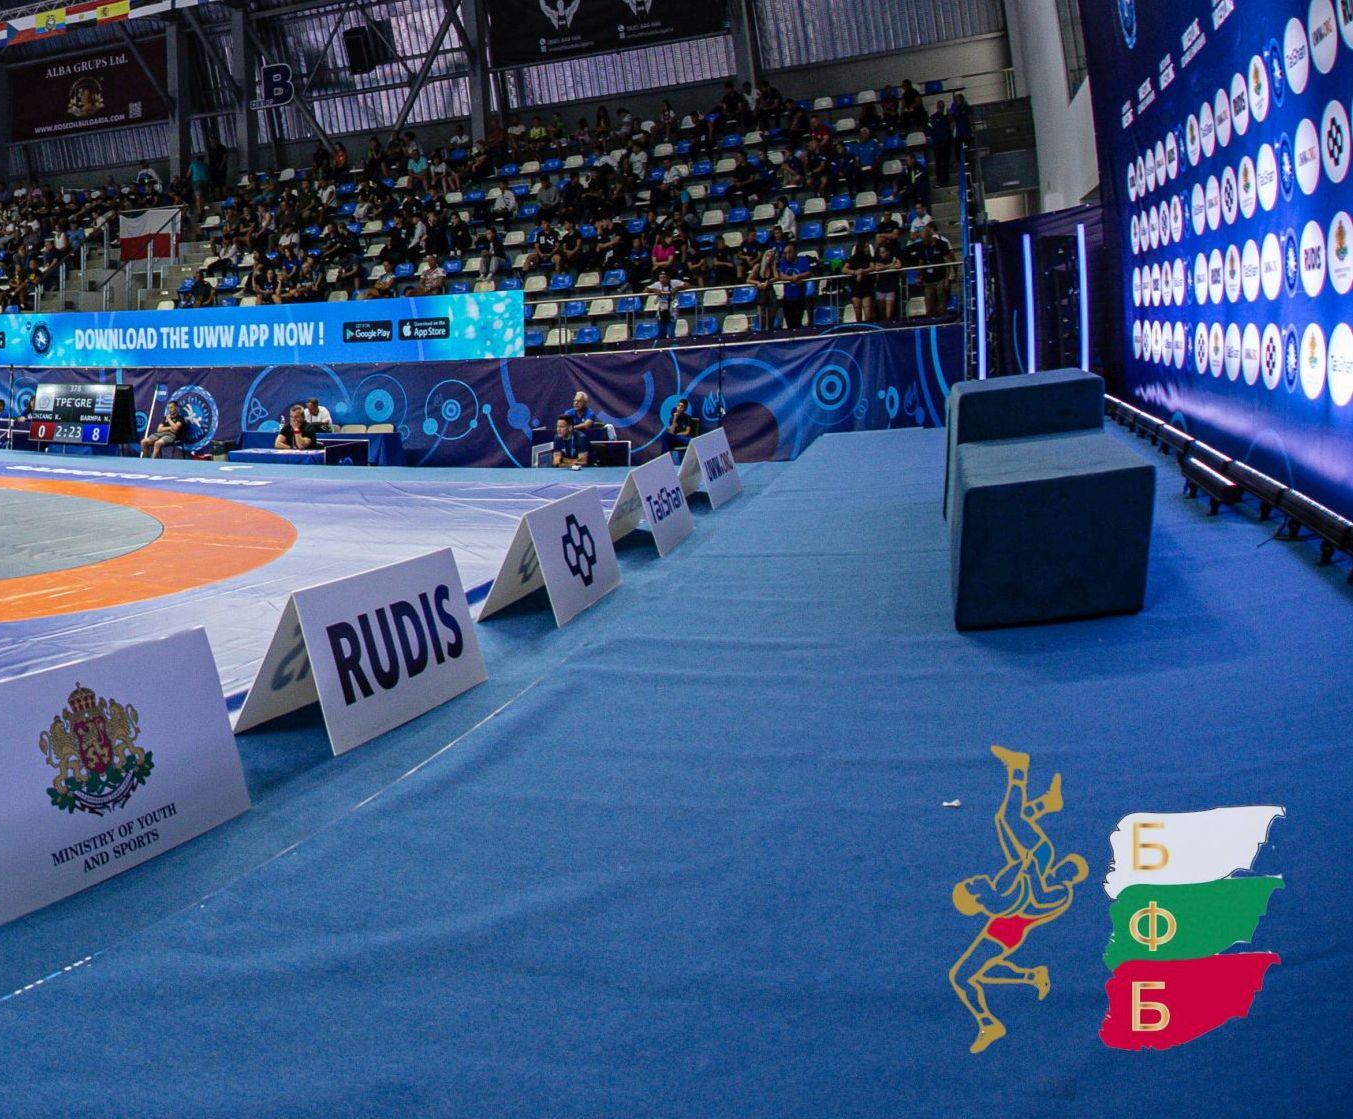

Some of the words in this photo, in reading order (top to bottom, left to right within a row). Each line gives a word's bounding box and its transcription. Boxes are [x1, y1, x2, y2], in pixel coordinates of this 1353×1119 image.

[45, 66, 72, 79] ALBA
[73, 57, 108, 73] GRUPS
[109, 54, 128, 66] Ltd.
[1304, 245, 1321, 271] RUDIS
[75, 327, 157, 350] DOWNLOAD
[161, 326, 189, 349] THE
[193, 325, 234, 349] UWW
[238, 323, 269, 347] APP
[274, 322, 314, 346] NOW
[319, 321, 324, 345] !
[355, 329, 376, 340] Google
[377, 329, 390, 338] Play
[414, 328, 427, 338] App
[428, 327, 446, 336] Store
[55, 397, 73, 408] TPE
[74, 398, 92, 408] GRE
[38, 425, 46, 438] 0
[55, 426, 82, 438] 2:23
[91, 427, 100, 440] 8
[646, 486, 685, 524] TaiShan
[326, 584, 464, 706] RUDIS
[51, 829, 115, 866] MINISTRY
[118, 820, 134, 838] OF
[137, 802, 177, 829] YOUTH
[84, 851, 110, 873] AND
[113, 829, 160, 858] SPORTS
